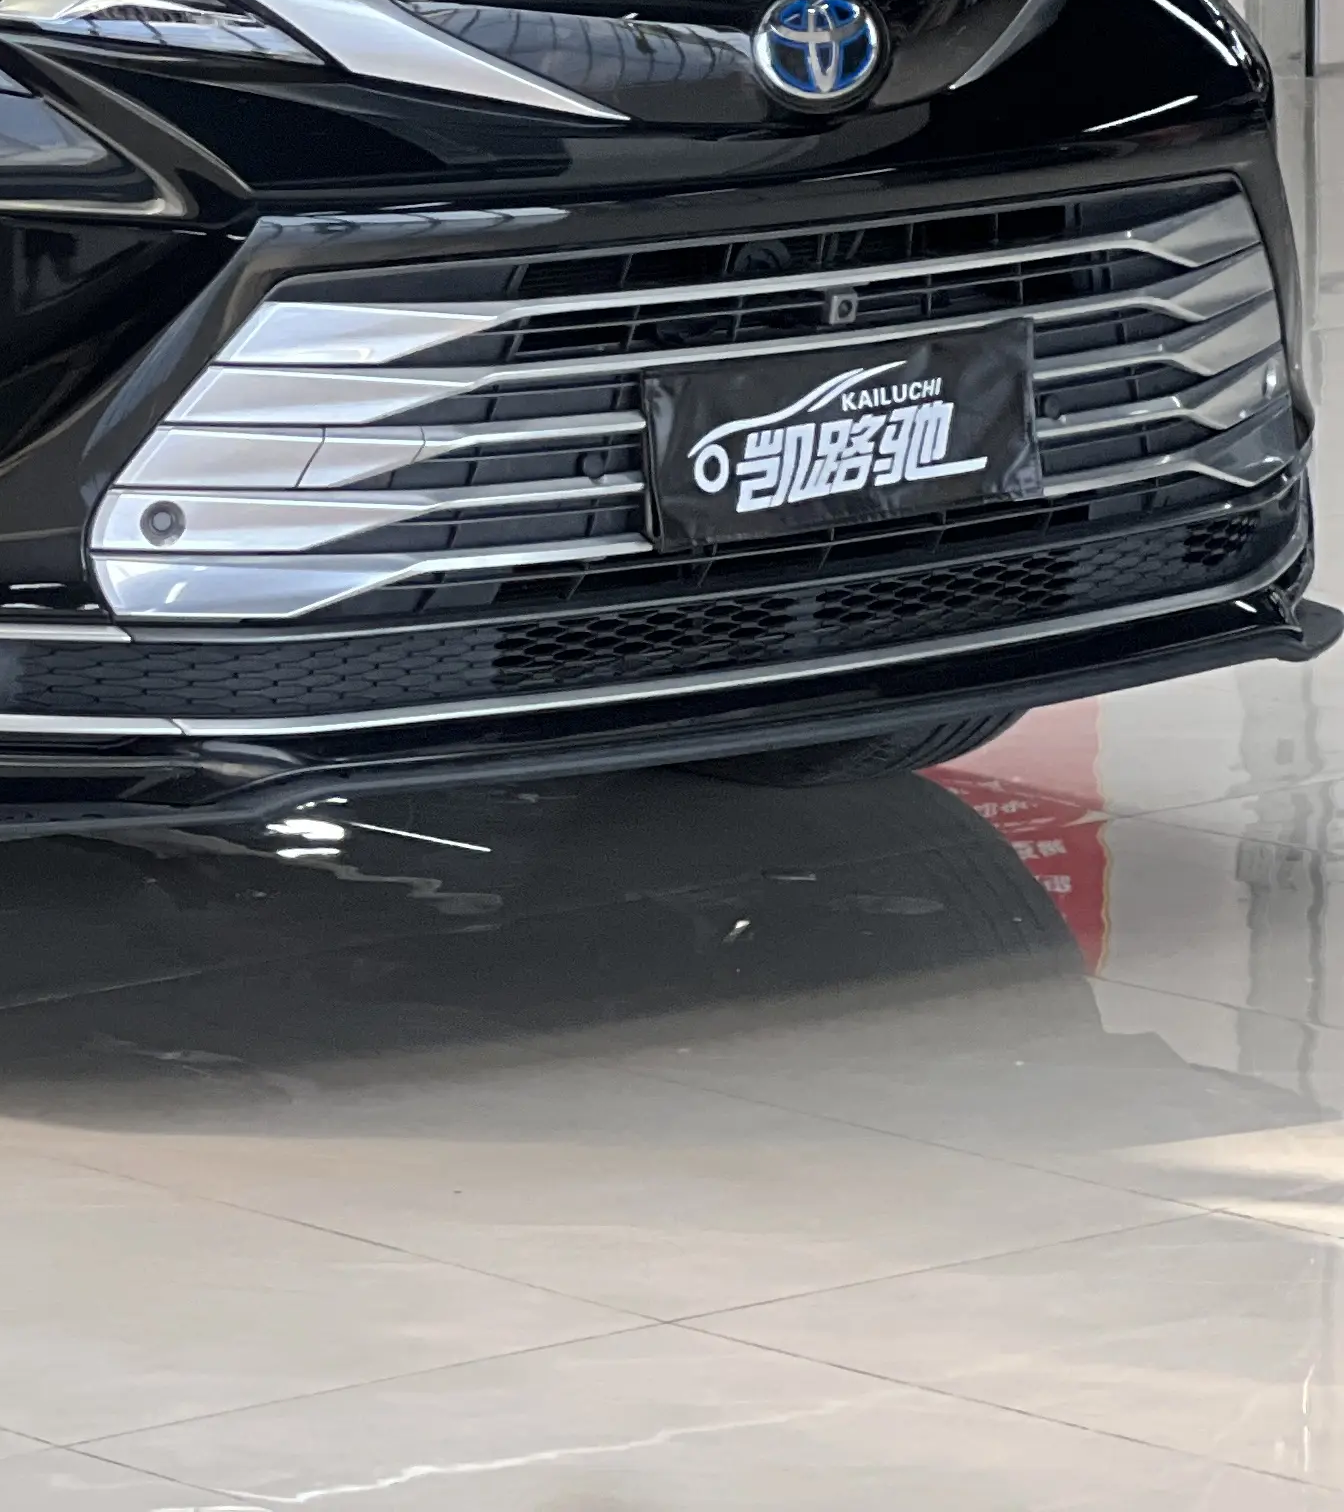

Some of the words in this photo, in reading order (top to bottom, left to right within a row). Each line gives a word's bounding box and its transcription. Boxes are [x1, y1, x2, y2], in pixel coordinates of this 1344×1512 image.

[841, 376, 943, 412] KAILUCHI
[735, 399, 988, 513] 凯路驰
